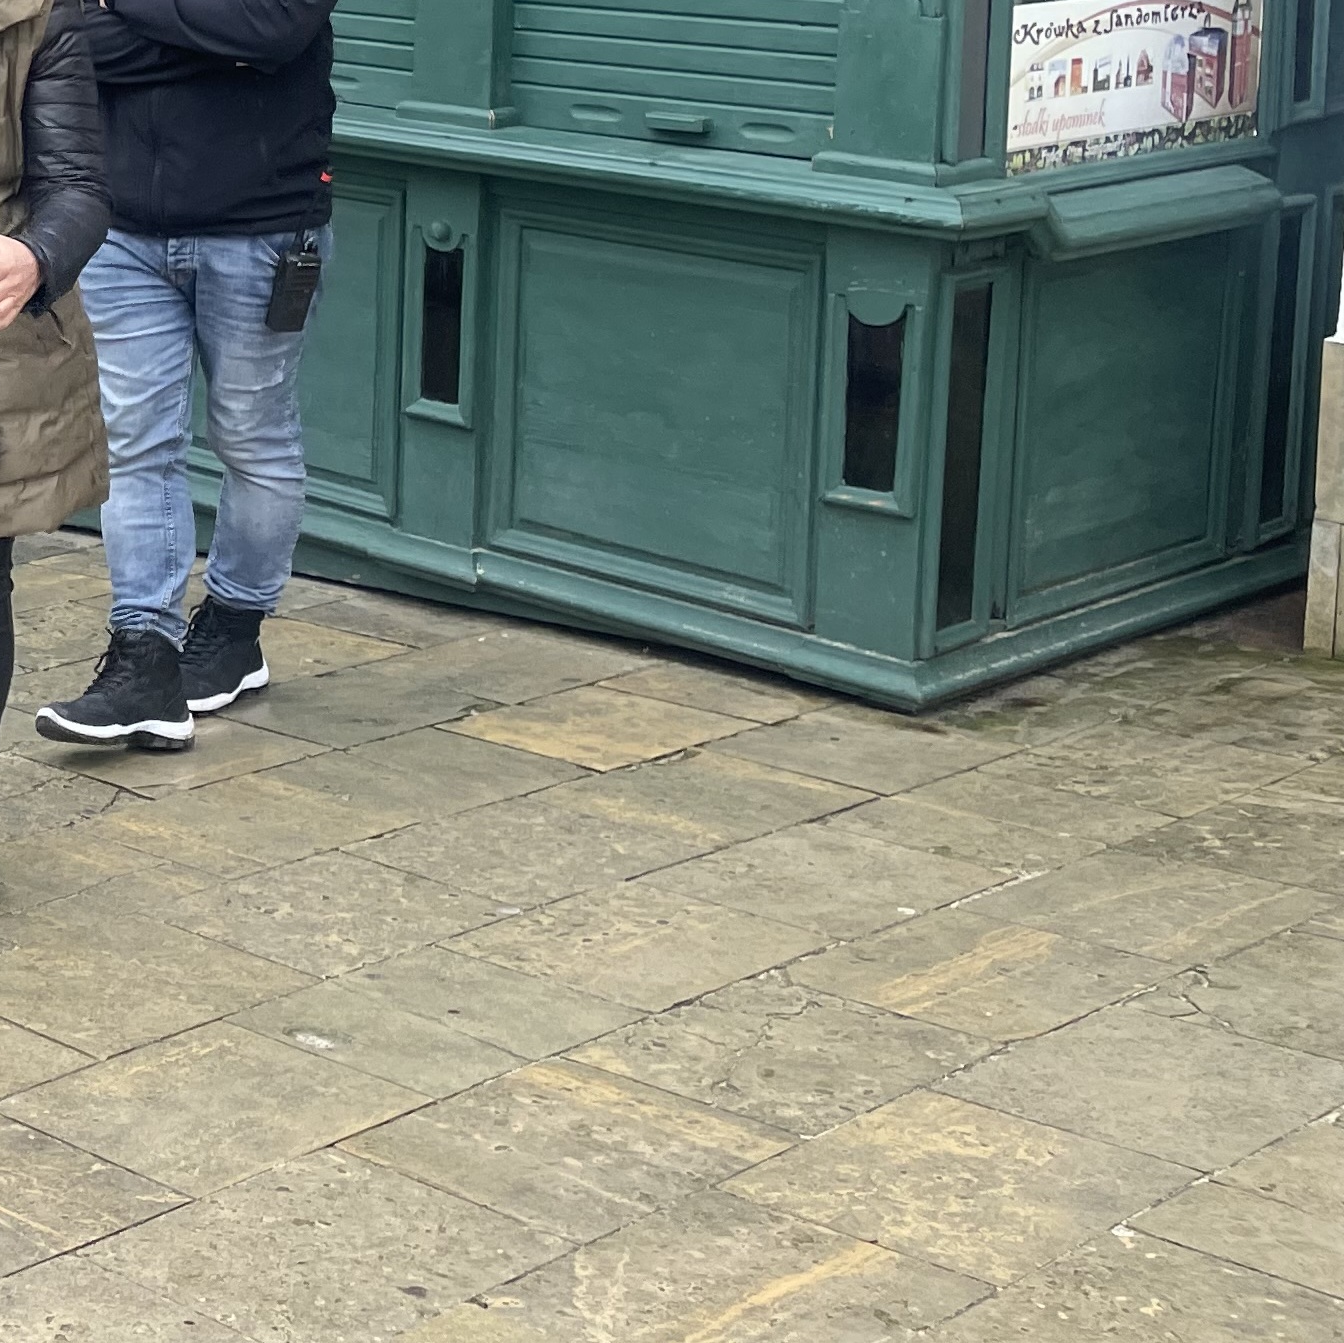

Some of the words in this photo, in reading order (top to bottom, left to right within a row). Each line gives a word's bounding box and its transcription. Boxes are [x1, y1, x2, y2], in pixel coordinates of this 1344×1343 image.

[1013, 18, 1087, 46] Krówka
[1092, 19, 1102, 36] z
[1103, 0, 1206, 34] Sandomierza
